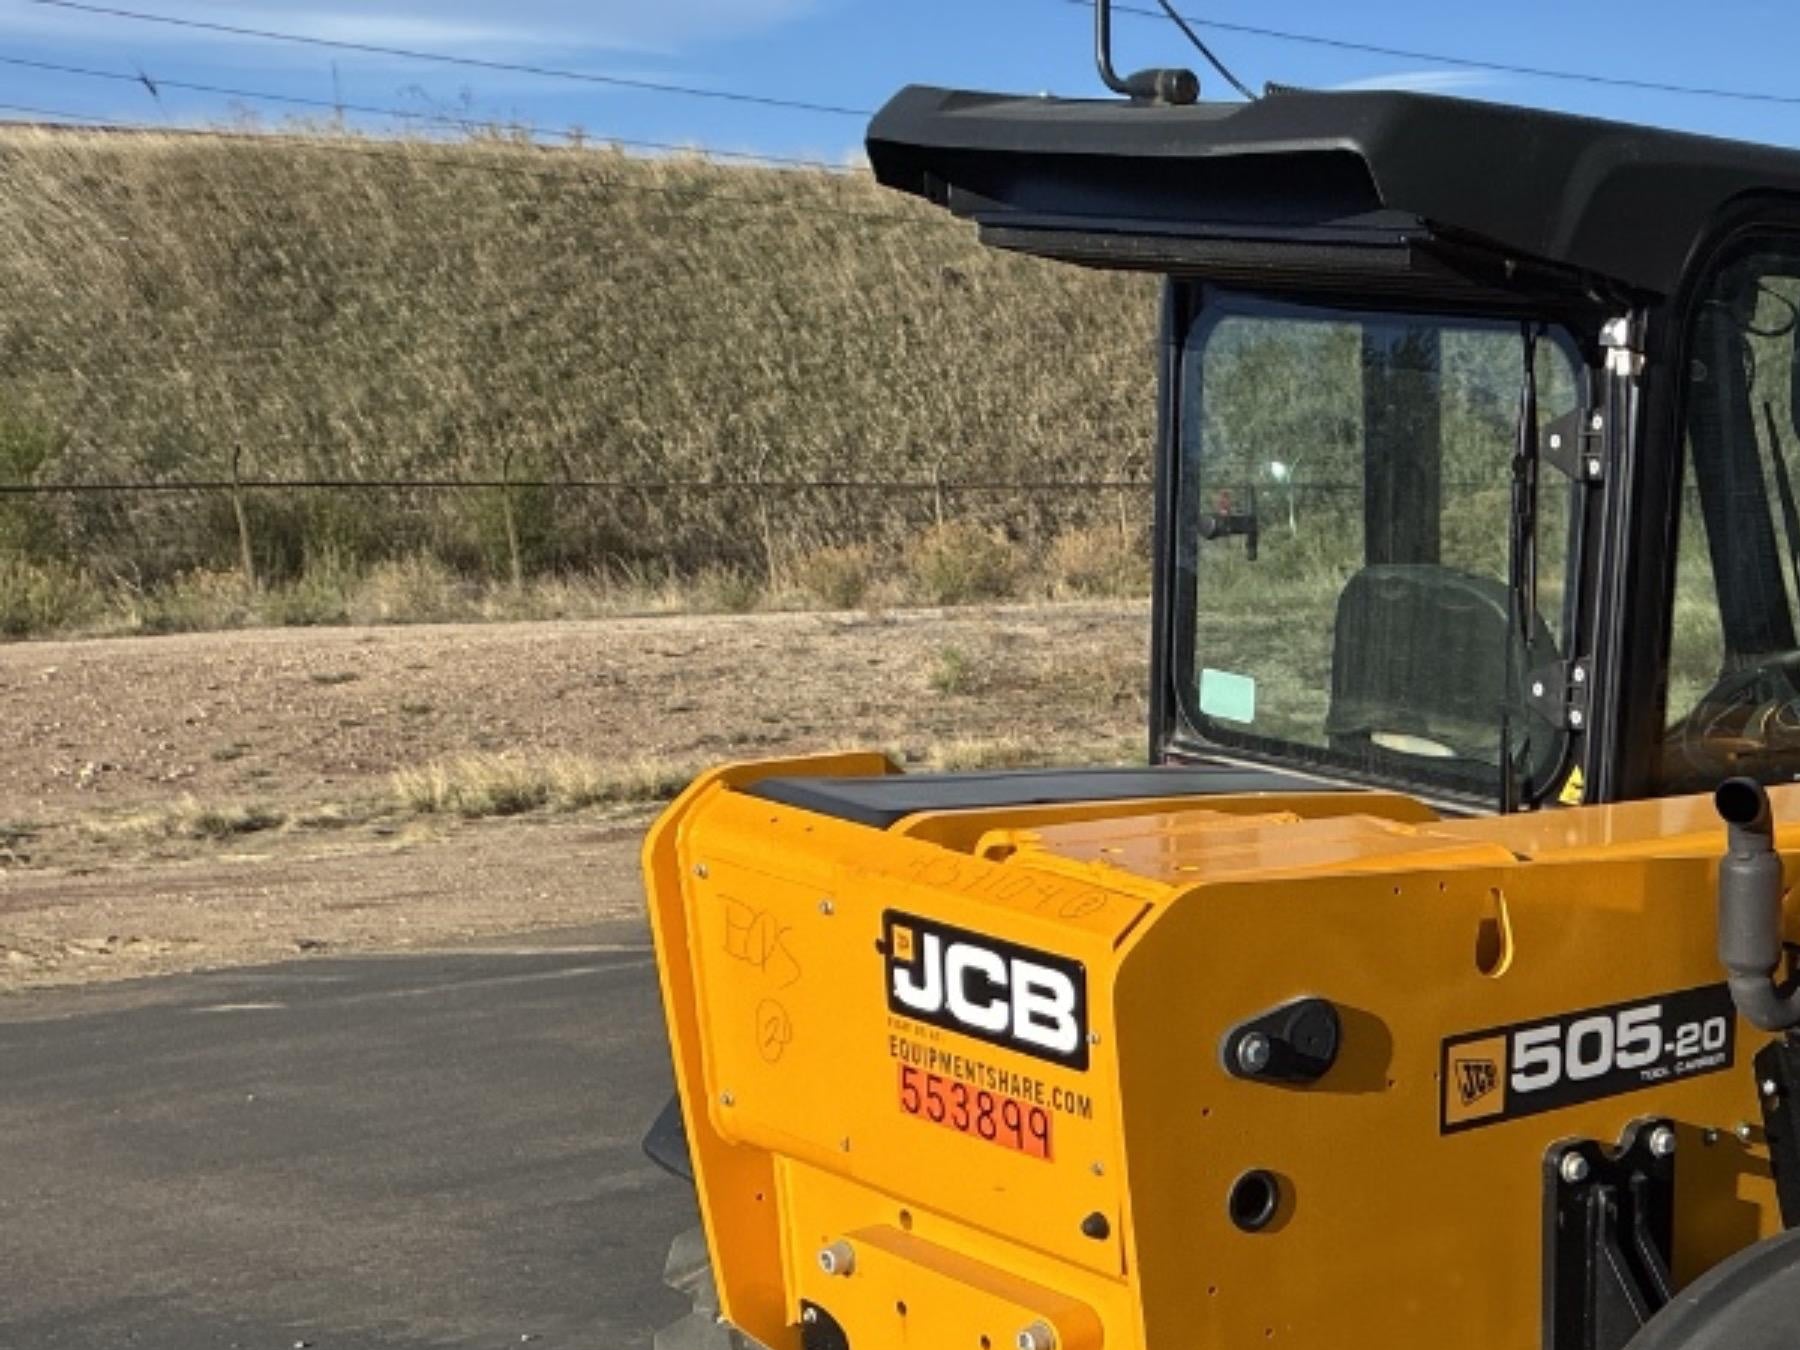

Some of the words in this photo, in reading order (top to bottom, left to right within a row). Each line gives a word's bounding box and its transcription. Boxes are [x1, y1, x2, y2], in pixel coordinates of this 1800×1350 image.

[893, 932, 1078, 1056] JCB
[889, 1035, 1094, 1120] EQUIPMENTSHARE.COM
[1510, 1004, 1727, 1093] 505-20
[901, 1064, 1051, 1159] 553899
